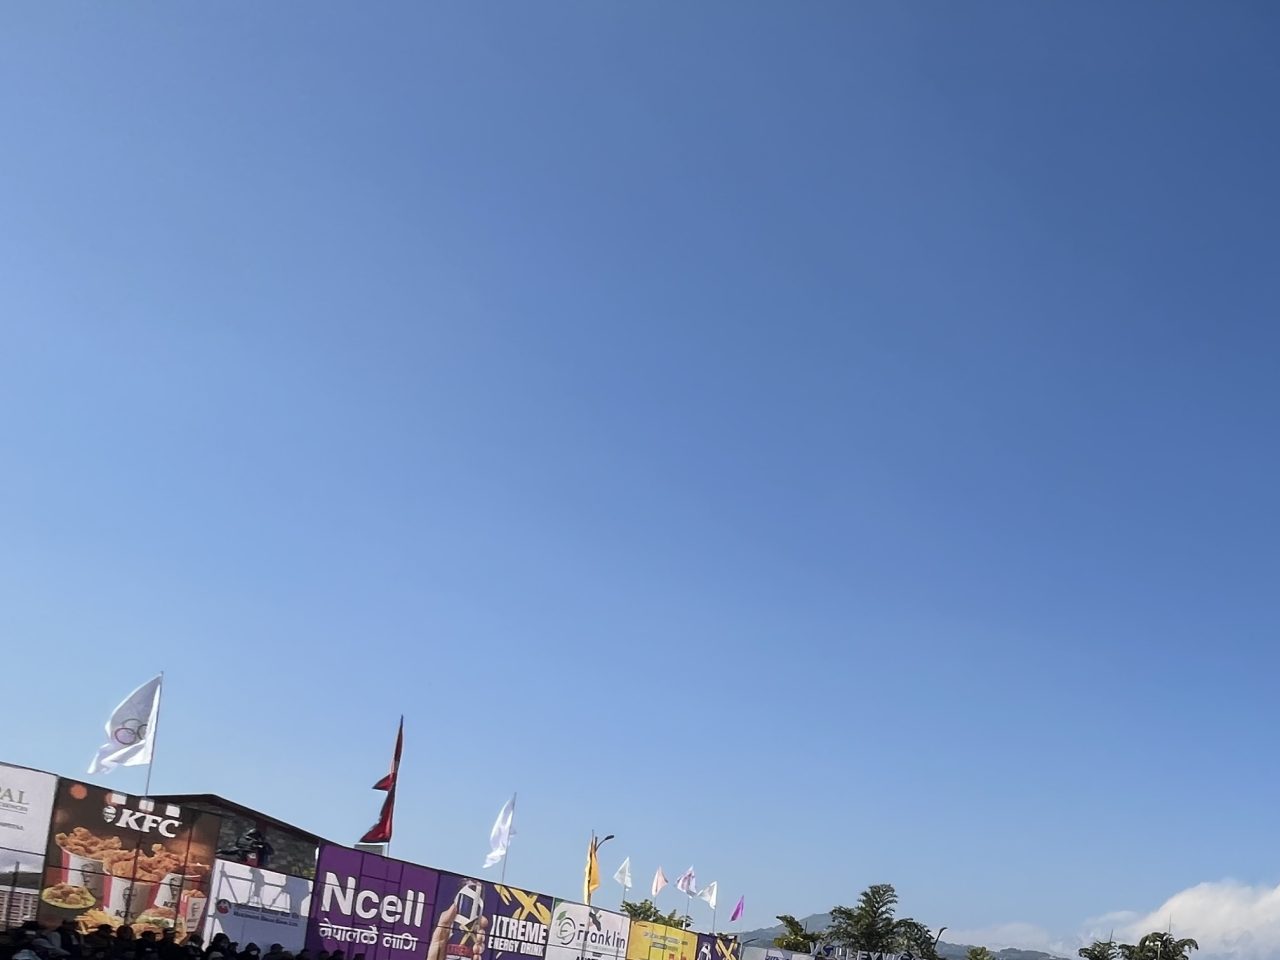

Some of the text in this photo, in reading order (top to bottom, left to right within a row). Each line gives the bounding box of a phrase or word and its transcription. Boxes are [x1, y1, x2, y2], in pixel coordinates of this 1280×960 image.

[0, 787, 29, 805] AL
[115, 808, 180, 838] KFC
[321, 871, 425, 928] Ncell
[383, 932, 419, 952] लागि
[489, 914, 547, 944] XTREME
[577, 923, 626, 949] Franklin
[488, 936, 520, 952] ENERGY
[520, 942, 546, 957] DRINK
